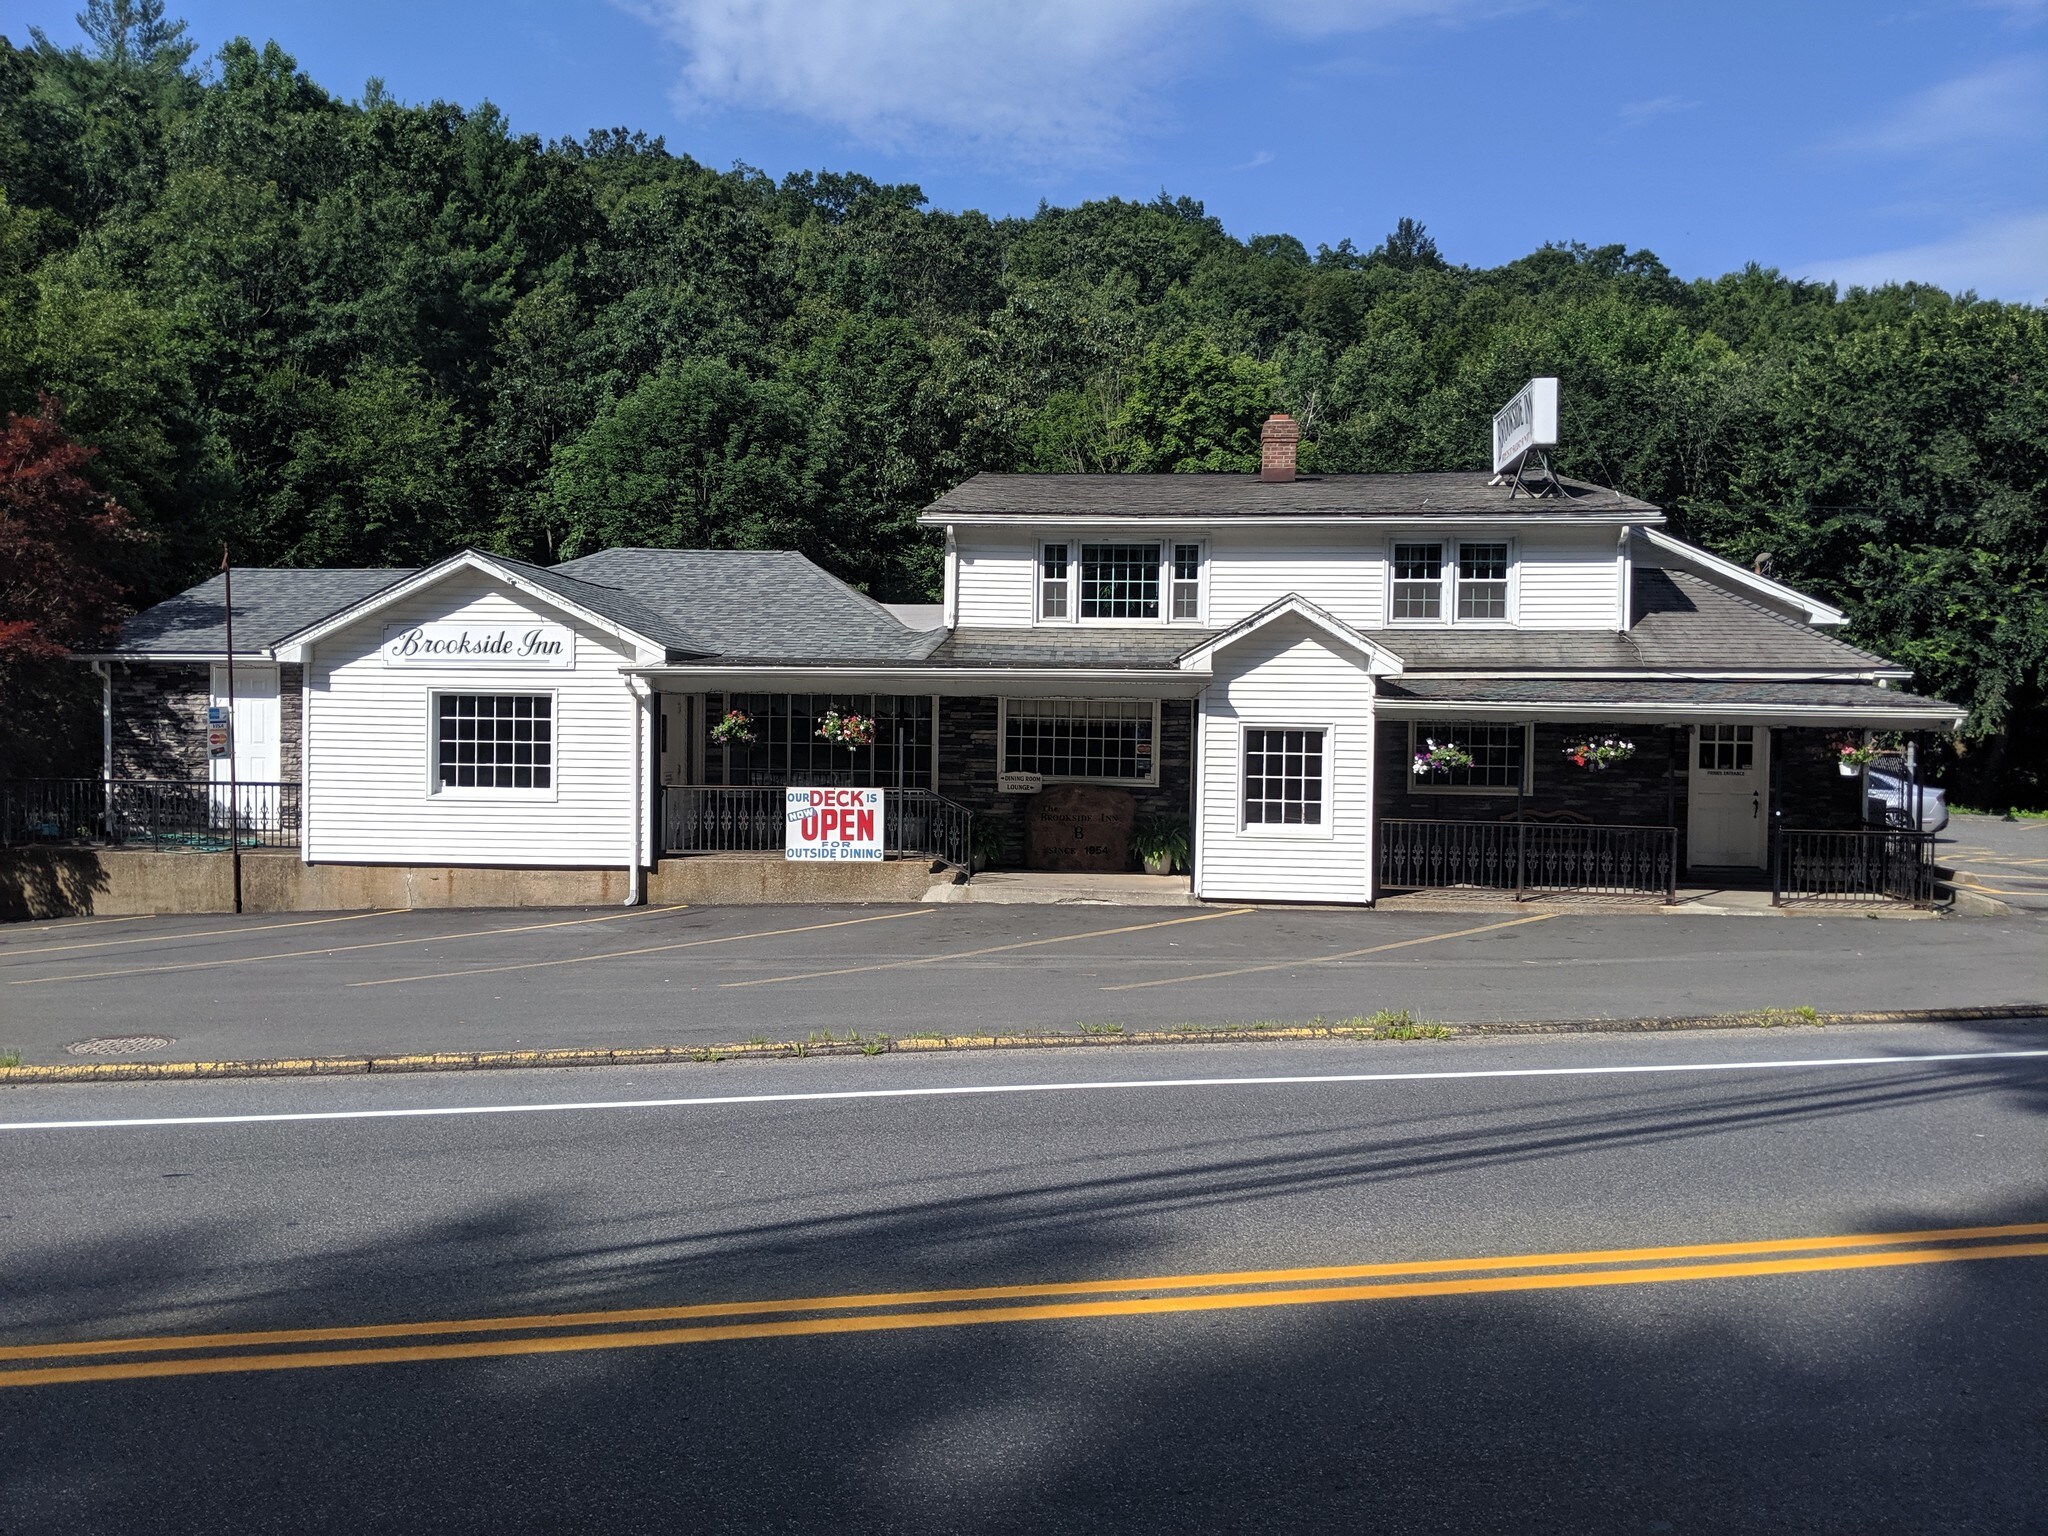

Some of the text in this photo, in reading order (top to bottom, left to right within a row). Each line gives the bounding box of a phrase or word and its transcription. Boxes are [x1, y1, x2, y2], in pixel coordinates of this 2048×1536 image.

[392, 627, 563, 656] Brookside Inn
[787, 790, 877, 807] OUR DECK IS
[788, 807, 815, 822] NOW
[1041, 813, 1119, 822] BROOKSIDE INN
[801, 808, 874, 841] OPEN
[1074, 825, 1084, 840] B
[786, 849, 882, 858] OUTSIDE DINING
[1048, 846, 1108, 855] SINCE 1954
